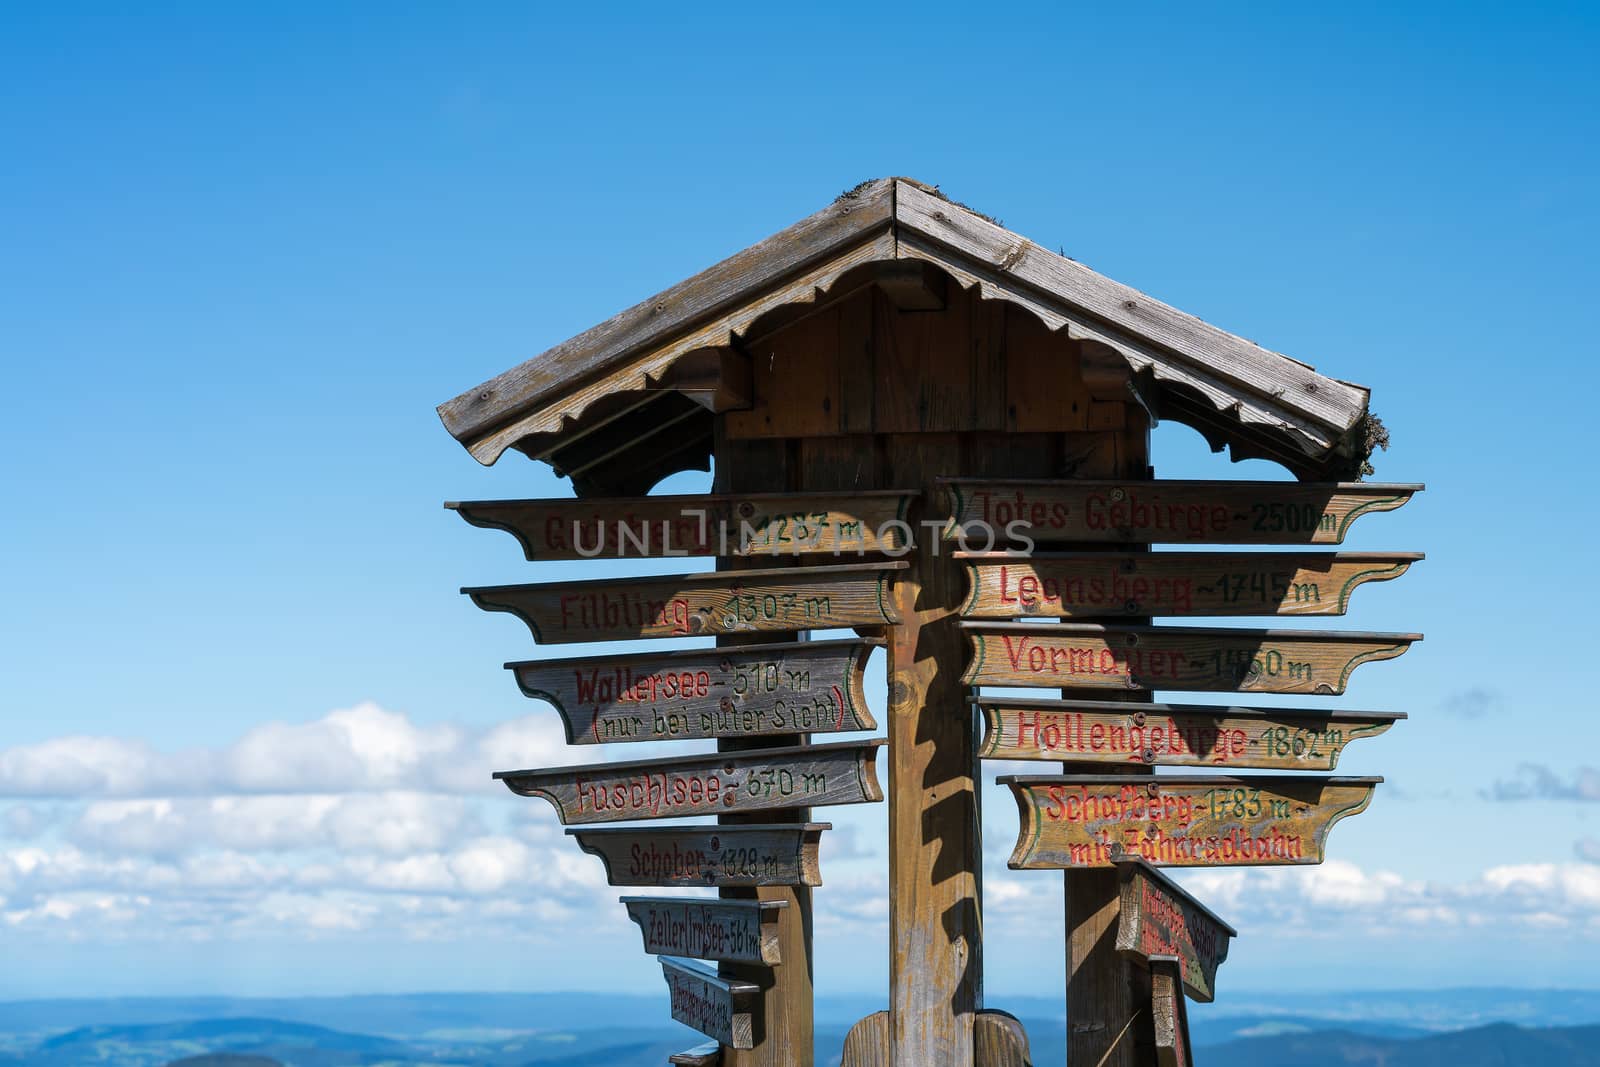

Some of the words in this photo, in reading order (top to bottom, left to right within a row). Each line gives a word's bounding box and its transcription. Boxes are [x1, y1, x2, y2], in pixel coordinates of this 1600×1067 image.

[973, 492, 1069, 529] Totes
[560, 593, 690, 635] Filbling
[726, 592, 798, 623] 1307
[652, 706, 690, 736] bei
